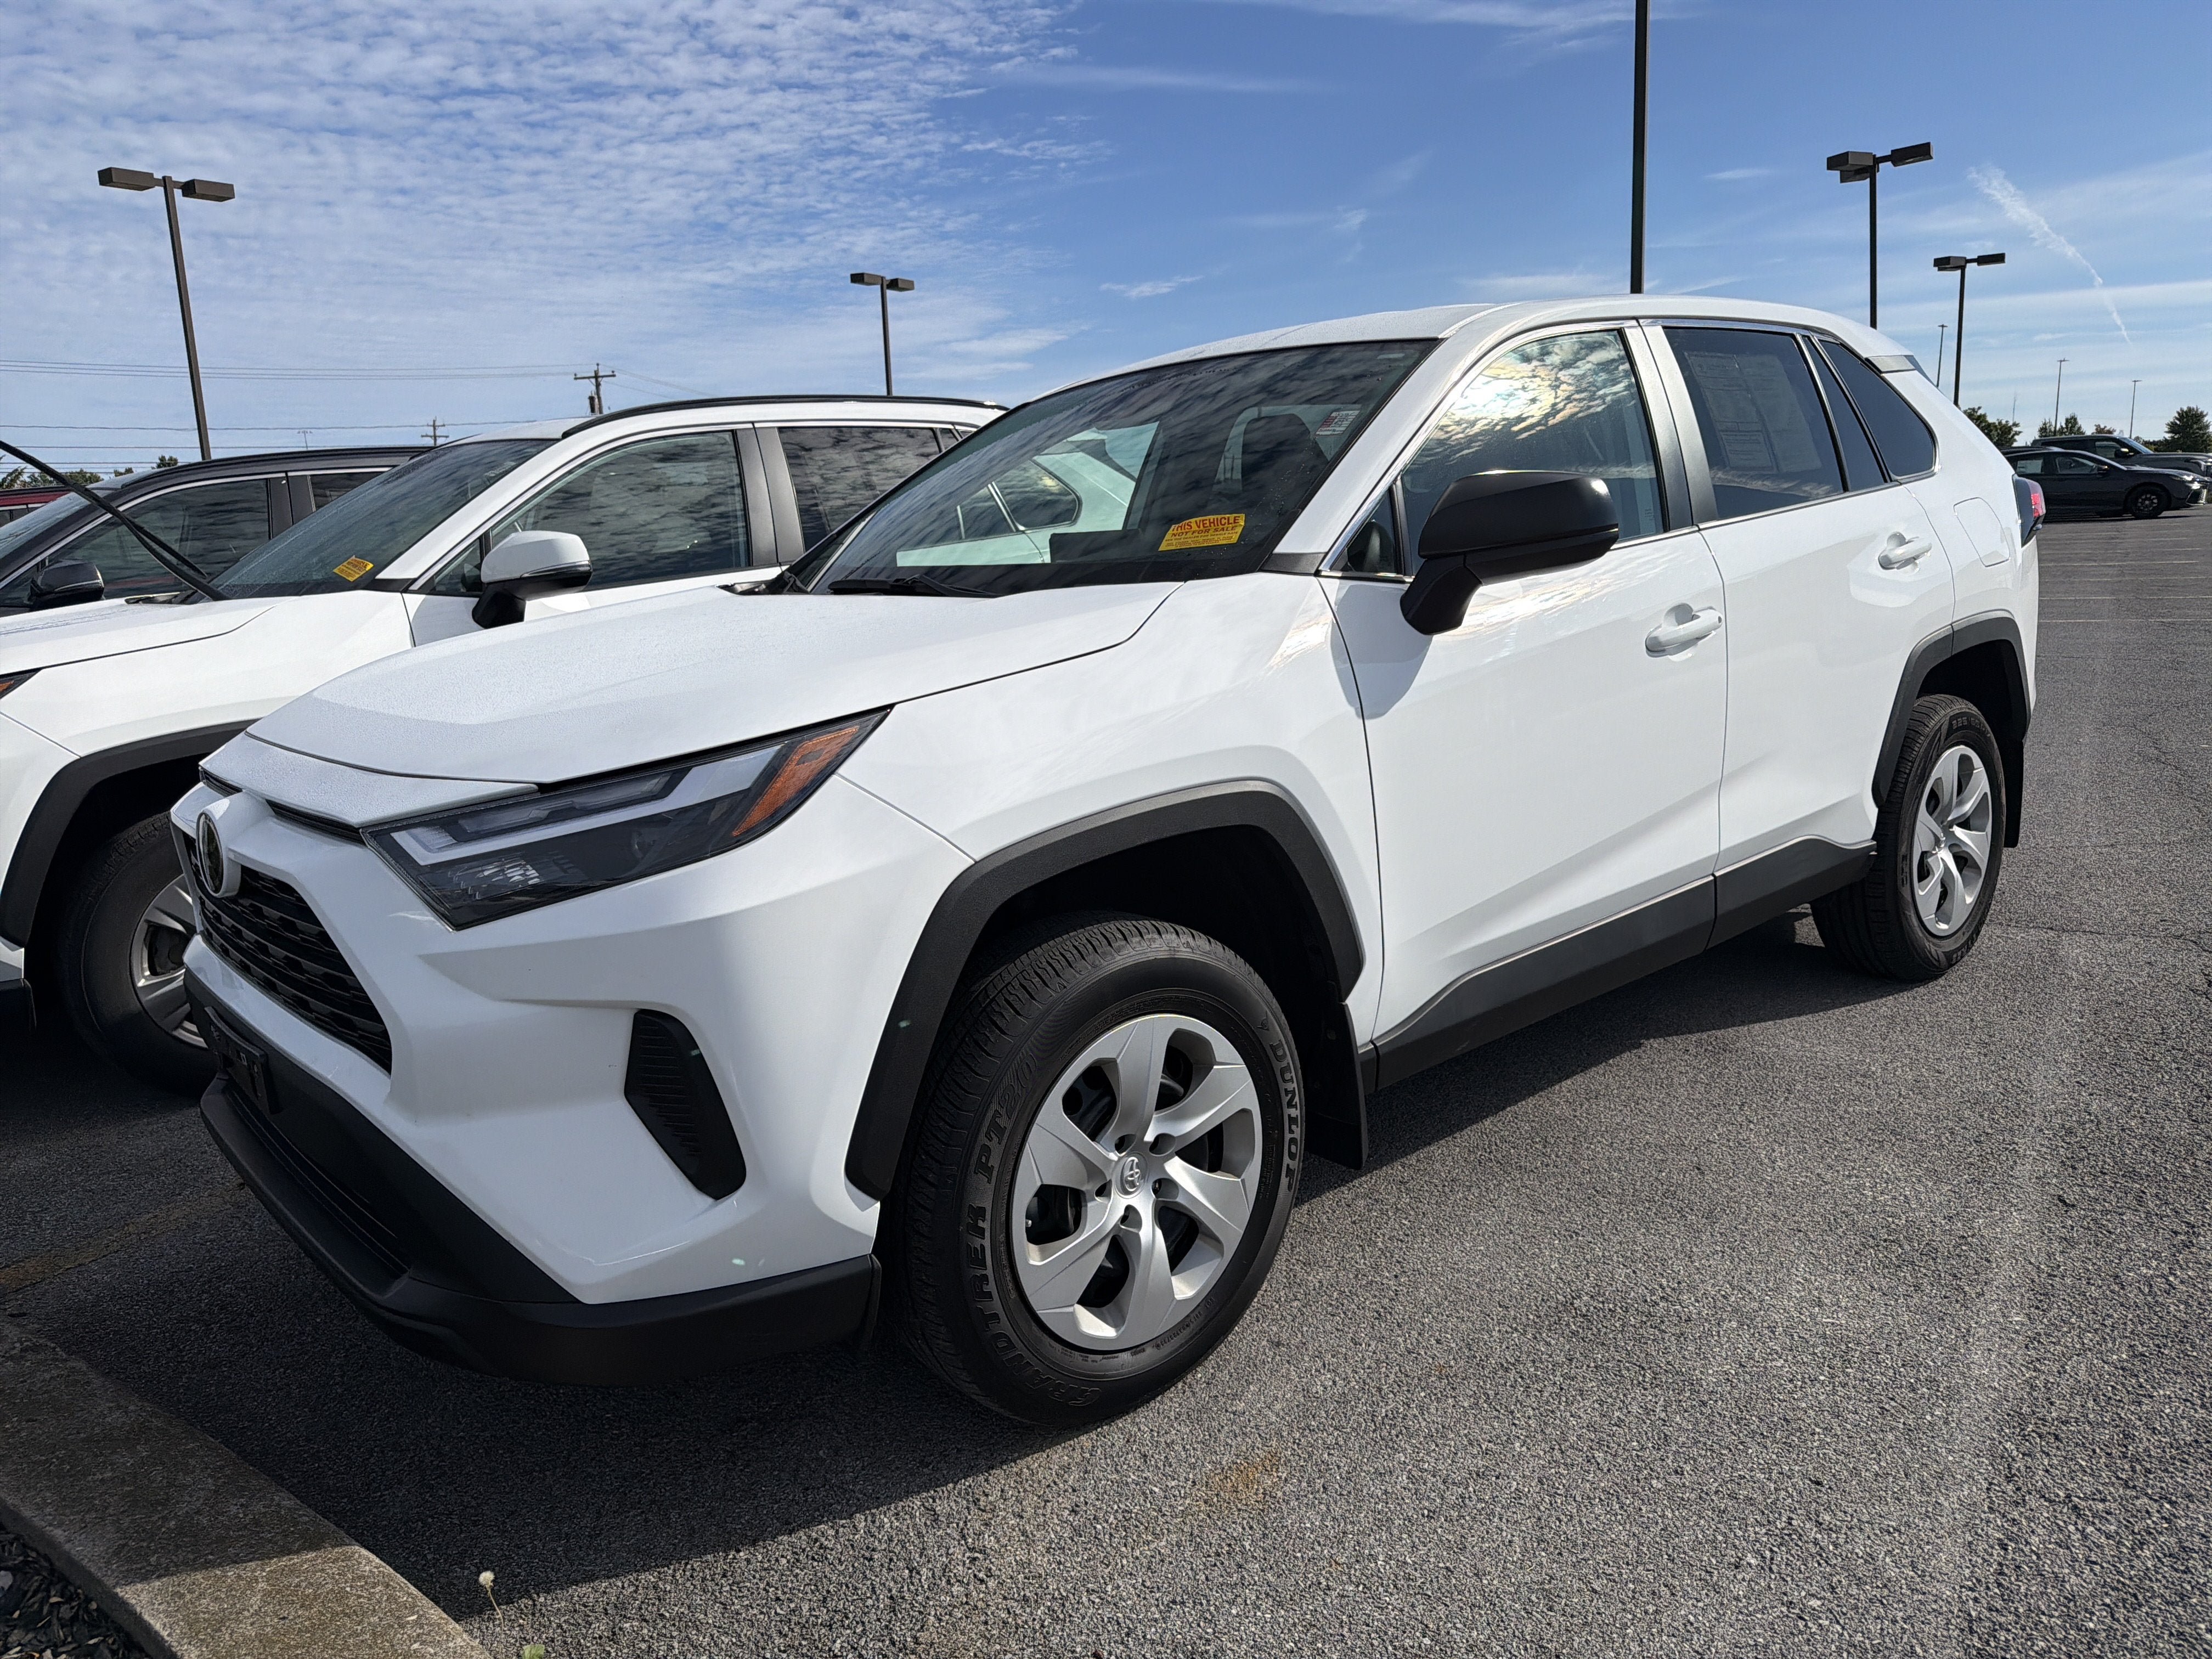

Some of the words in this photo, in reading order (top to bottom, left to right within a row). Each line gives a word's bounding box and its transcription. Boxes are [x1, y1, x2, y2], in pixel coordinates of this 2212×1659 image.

[1172, 521, 1193, 532] THIS
[1195, 516, 1240, 529] VEHICLE
[975, 1052, 1037, 1184] PT20
[1269, 1039, 1299, 1192] DUNLOP
[967, 1204, 1102, 1407] GRANDTREK
